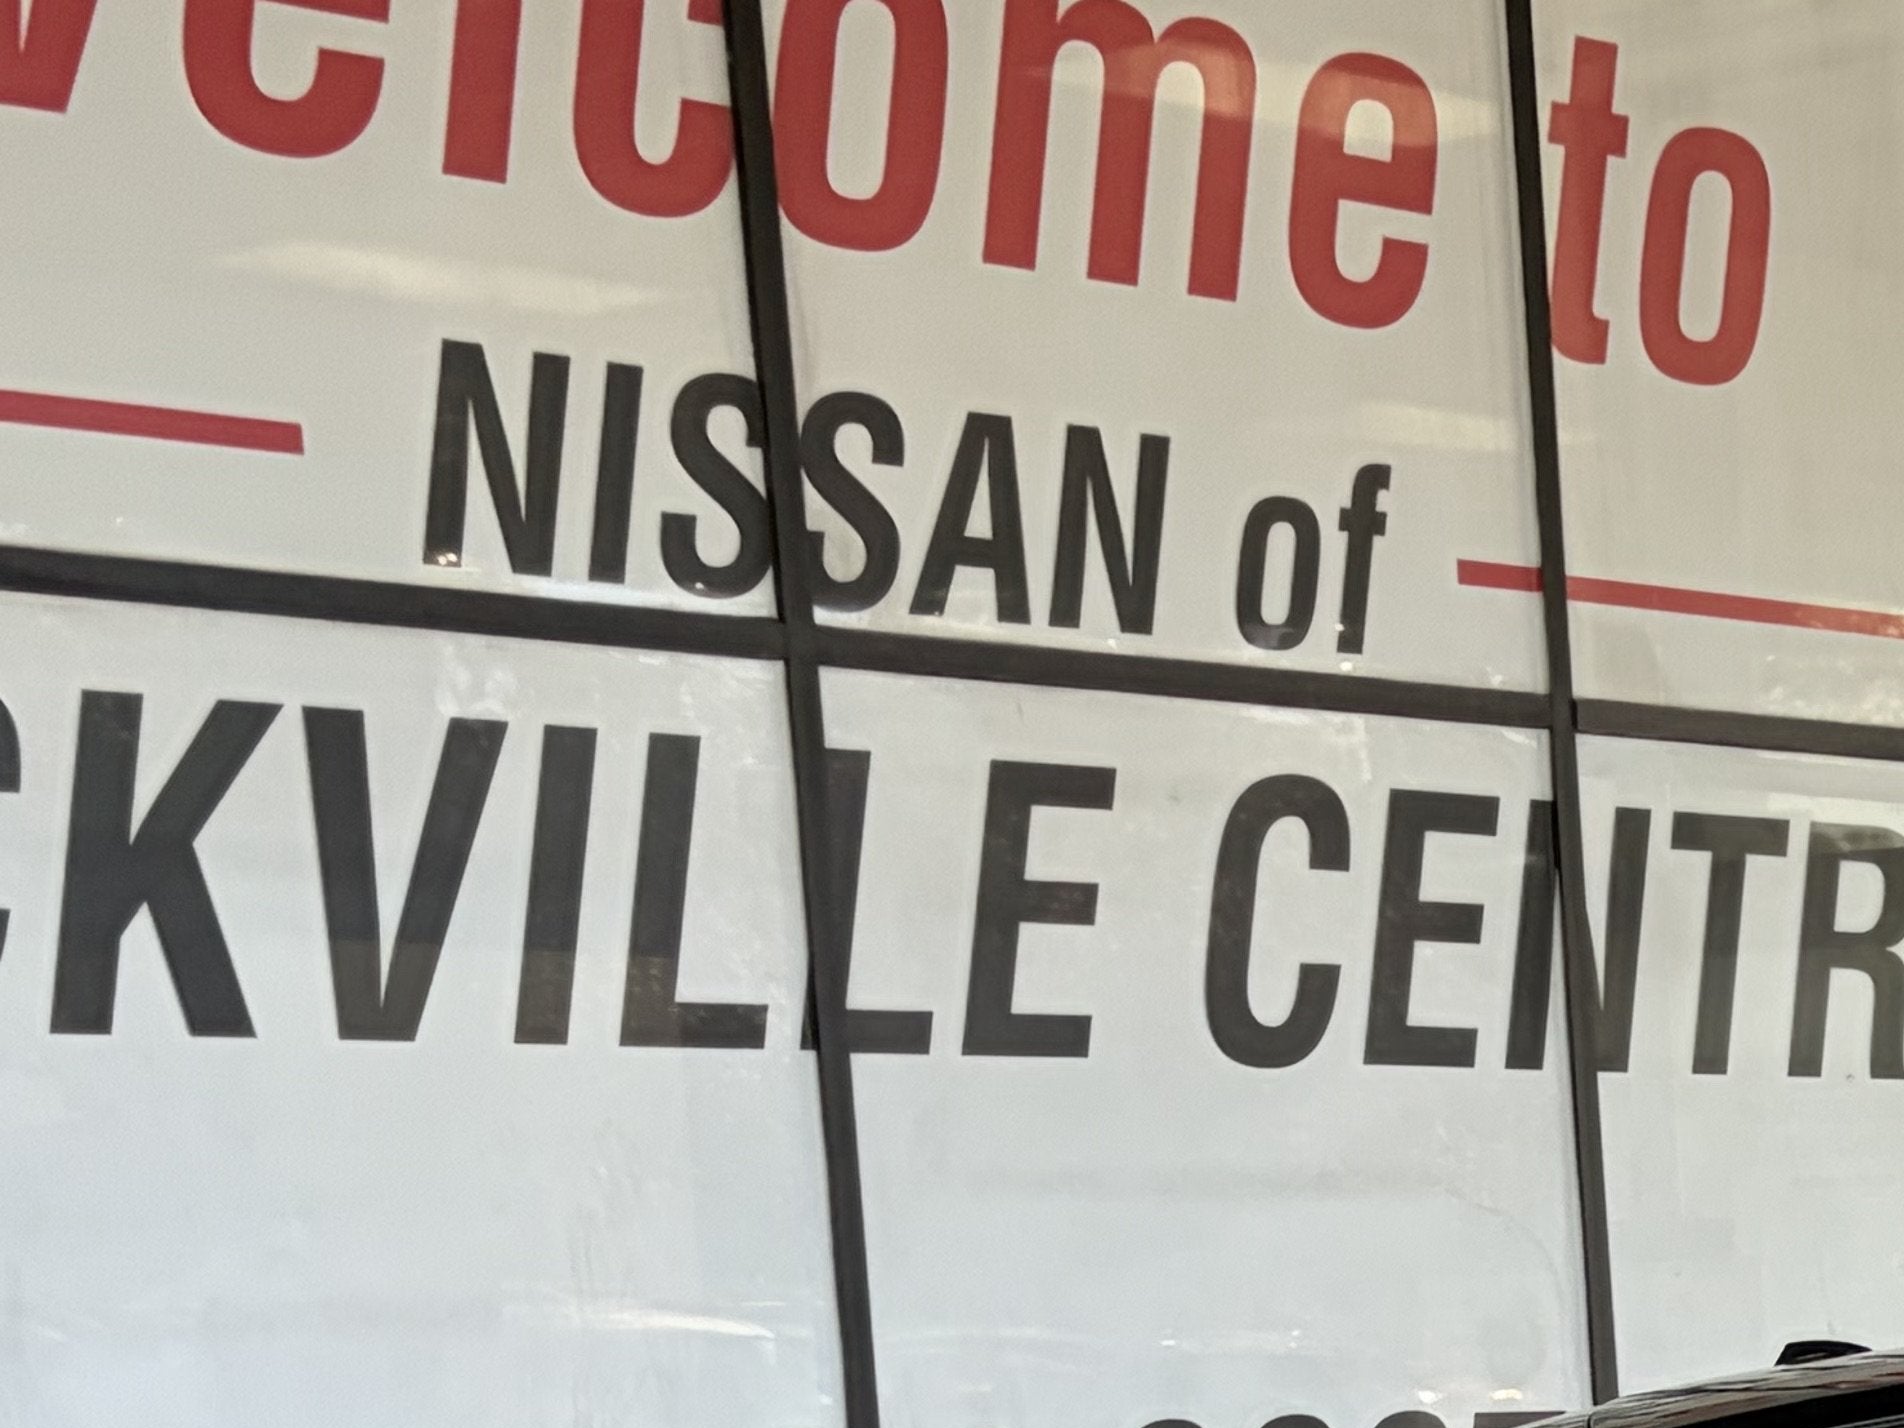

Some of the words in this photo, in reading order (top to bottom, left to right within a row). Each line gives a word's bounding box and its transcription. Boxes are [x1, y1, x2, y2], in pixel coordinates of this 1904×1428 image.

[1549, 39, 1771, 384] to
[422, 338, 1171, 637] NISSAN
[1234, 463, 1391, 656] of
[0, 688, 1117, 1058] KVILLE
